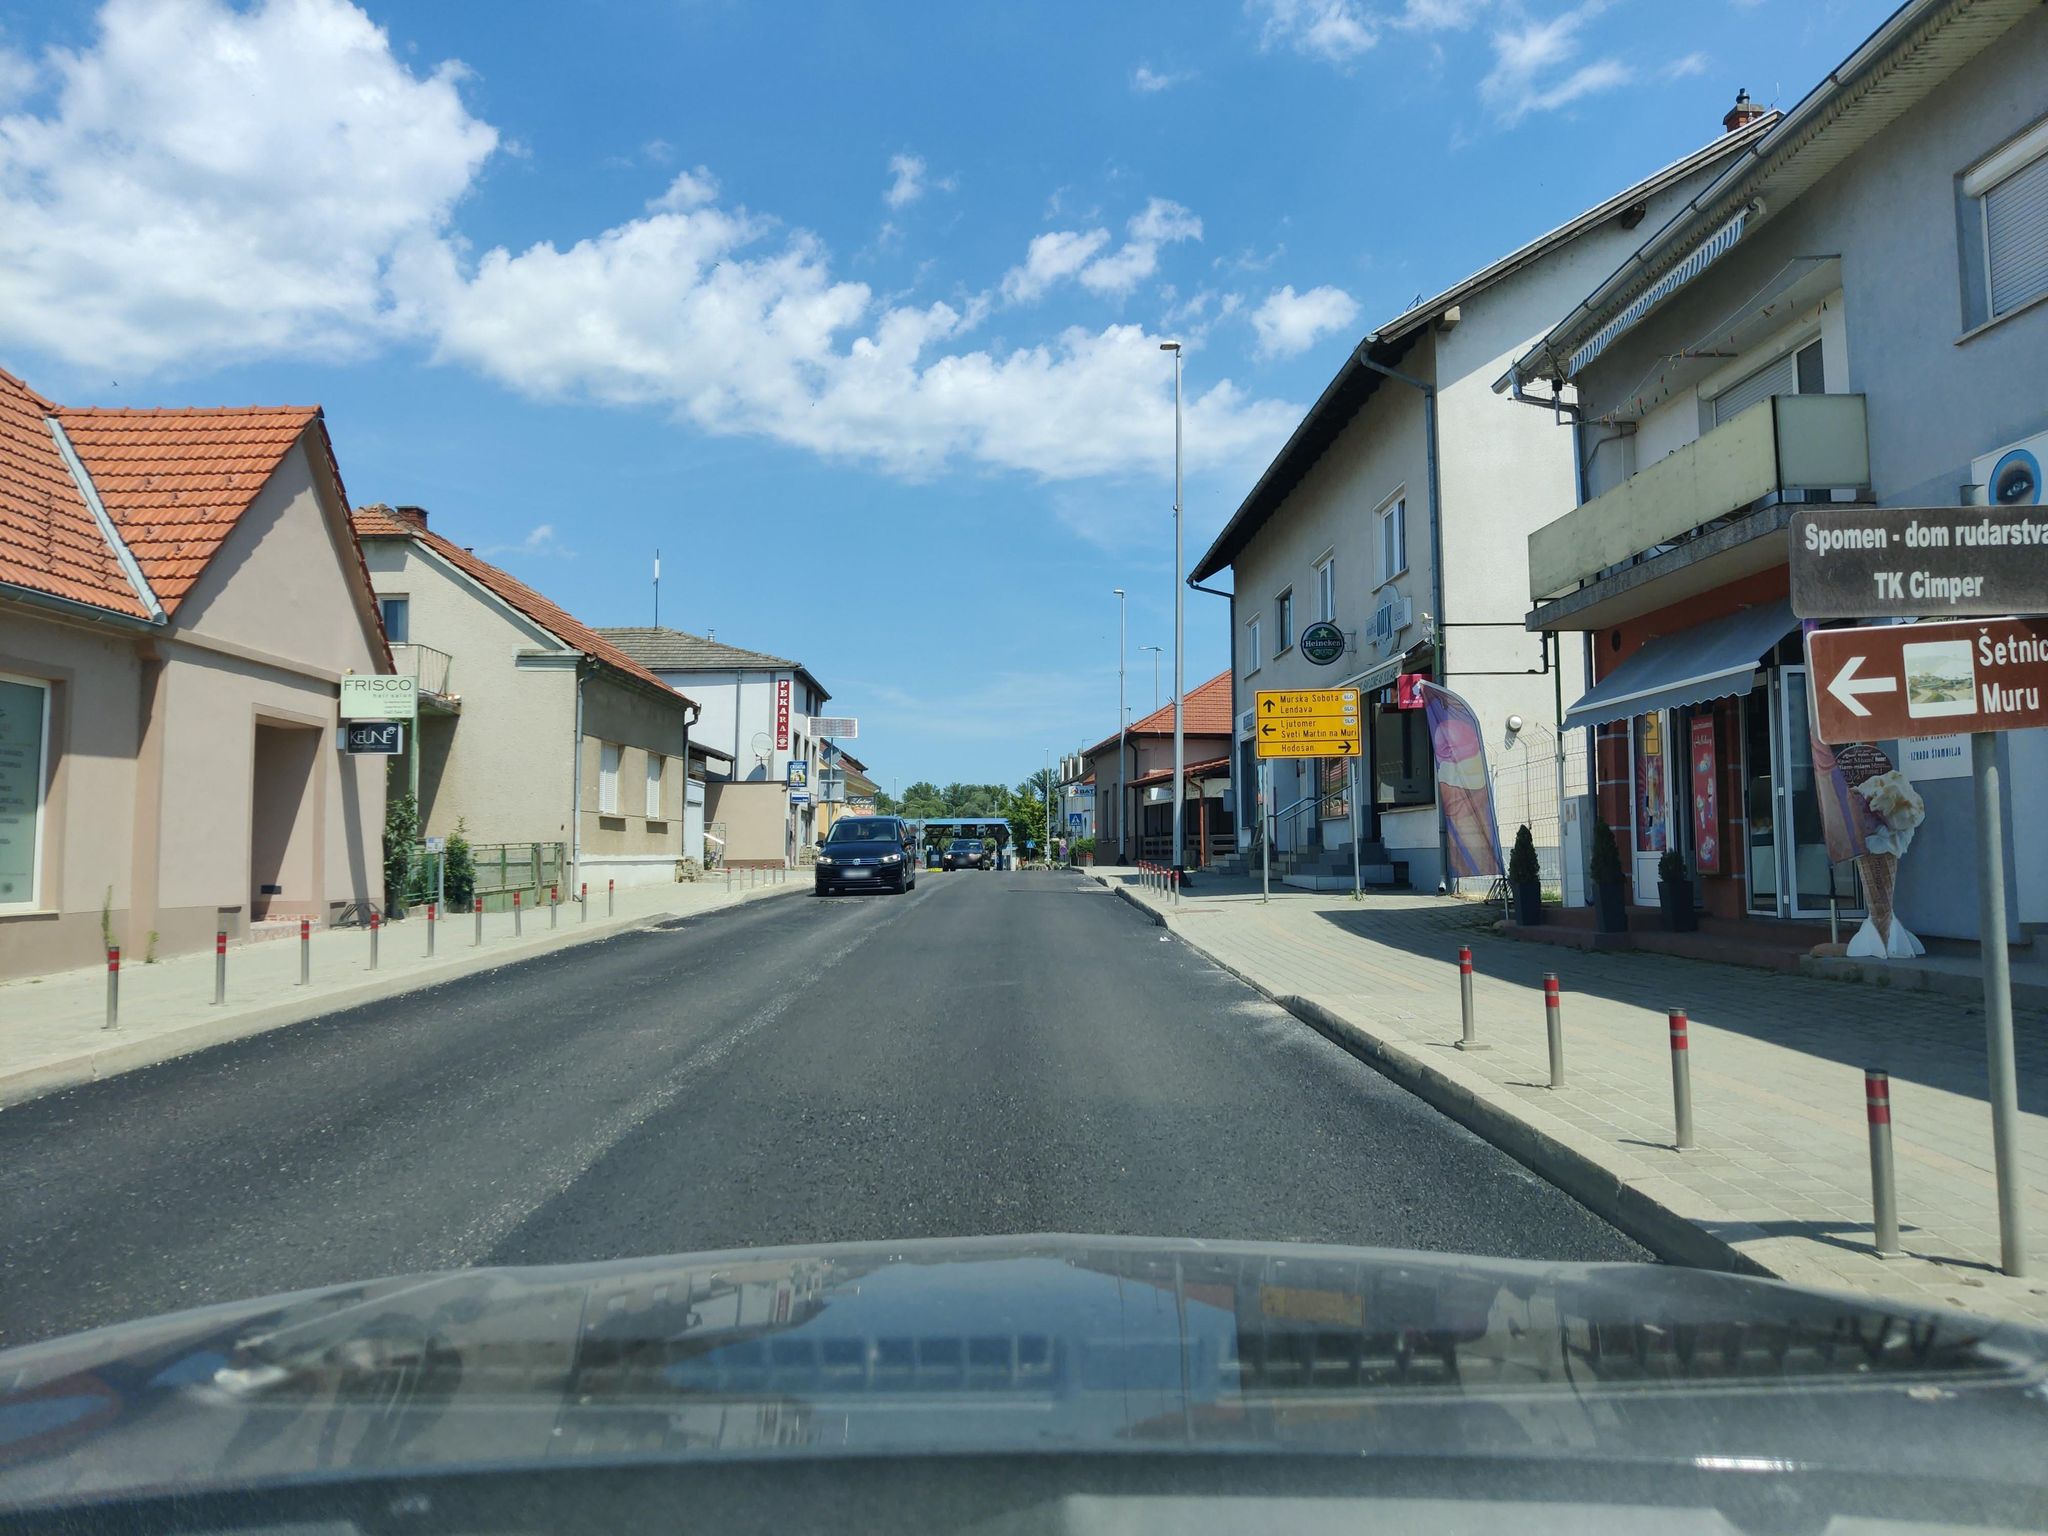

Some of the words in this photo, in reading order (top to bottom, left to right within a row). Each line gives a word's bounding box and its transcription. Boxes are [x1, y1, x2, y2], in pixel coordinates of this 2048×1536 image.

[1804, 523, 1887, 556] Spomen
[1905, 520, 1949, 547] dom
[1874, 572, 1904, 599] TK
[1909, 571, 1984, 604] Cimper
[1305, 639, 1341, 648] Heineken
[344, 679, 412, 691] FRISCO
[1280, 694, 1309, 703] Murska
[1312, 694, 1339, 703] Sobota
[1982, 682, 2040, 714] Muru
[779, 681, 788, 732] PEKARA
[1280, 705, 1313, 714] Lendava
[1280, 719, 1316, 729] Ljutomer
[350, 730, 393, 744] KEUNE
[1281, 730, 1301, 738] Sveti
[1303, 729, 1327, 738] Martin
[1340, 728, 1357, 737] Muri
